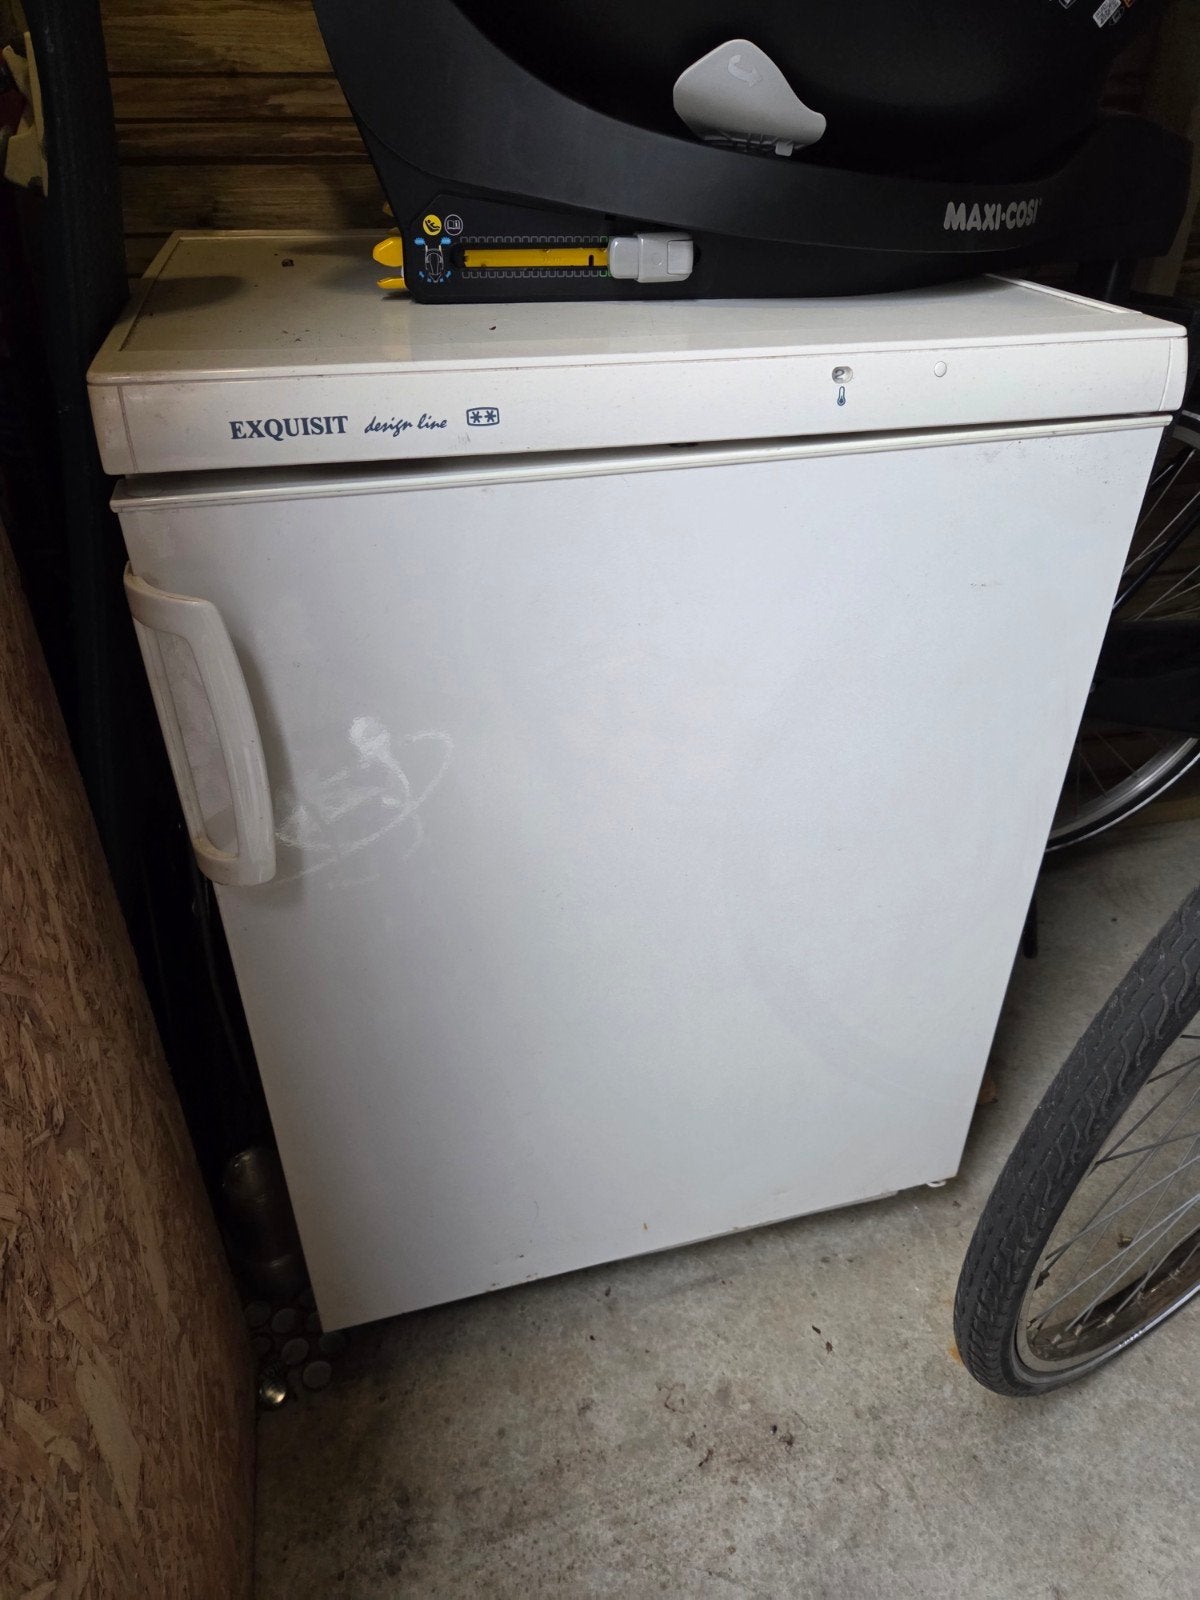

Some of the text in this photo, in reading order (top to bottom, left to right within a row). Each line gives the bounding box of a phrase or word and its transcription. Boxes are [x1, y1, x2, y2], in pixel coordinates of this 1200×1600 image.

[833, 368, 846, 380] 2
[229, 415, 348, 441] EXQUISIT
[364, 413, 448, 437] design line
